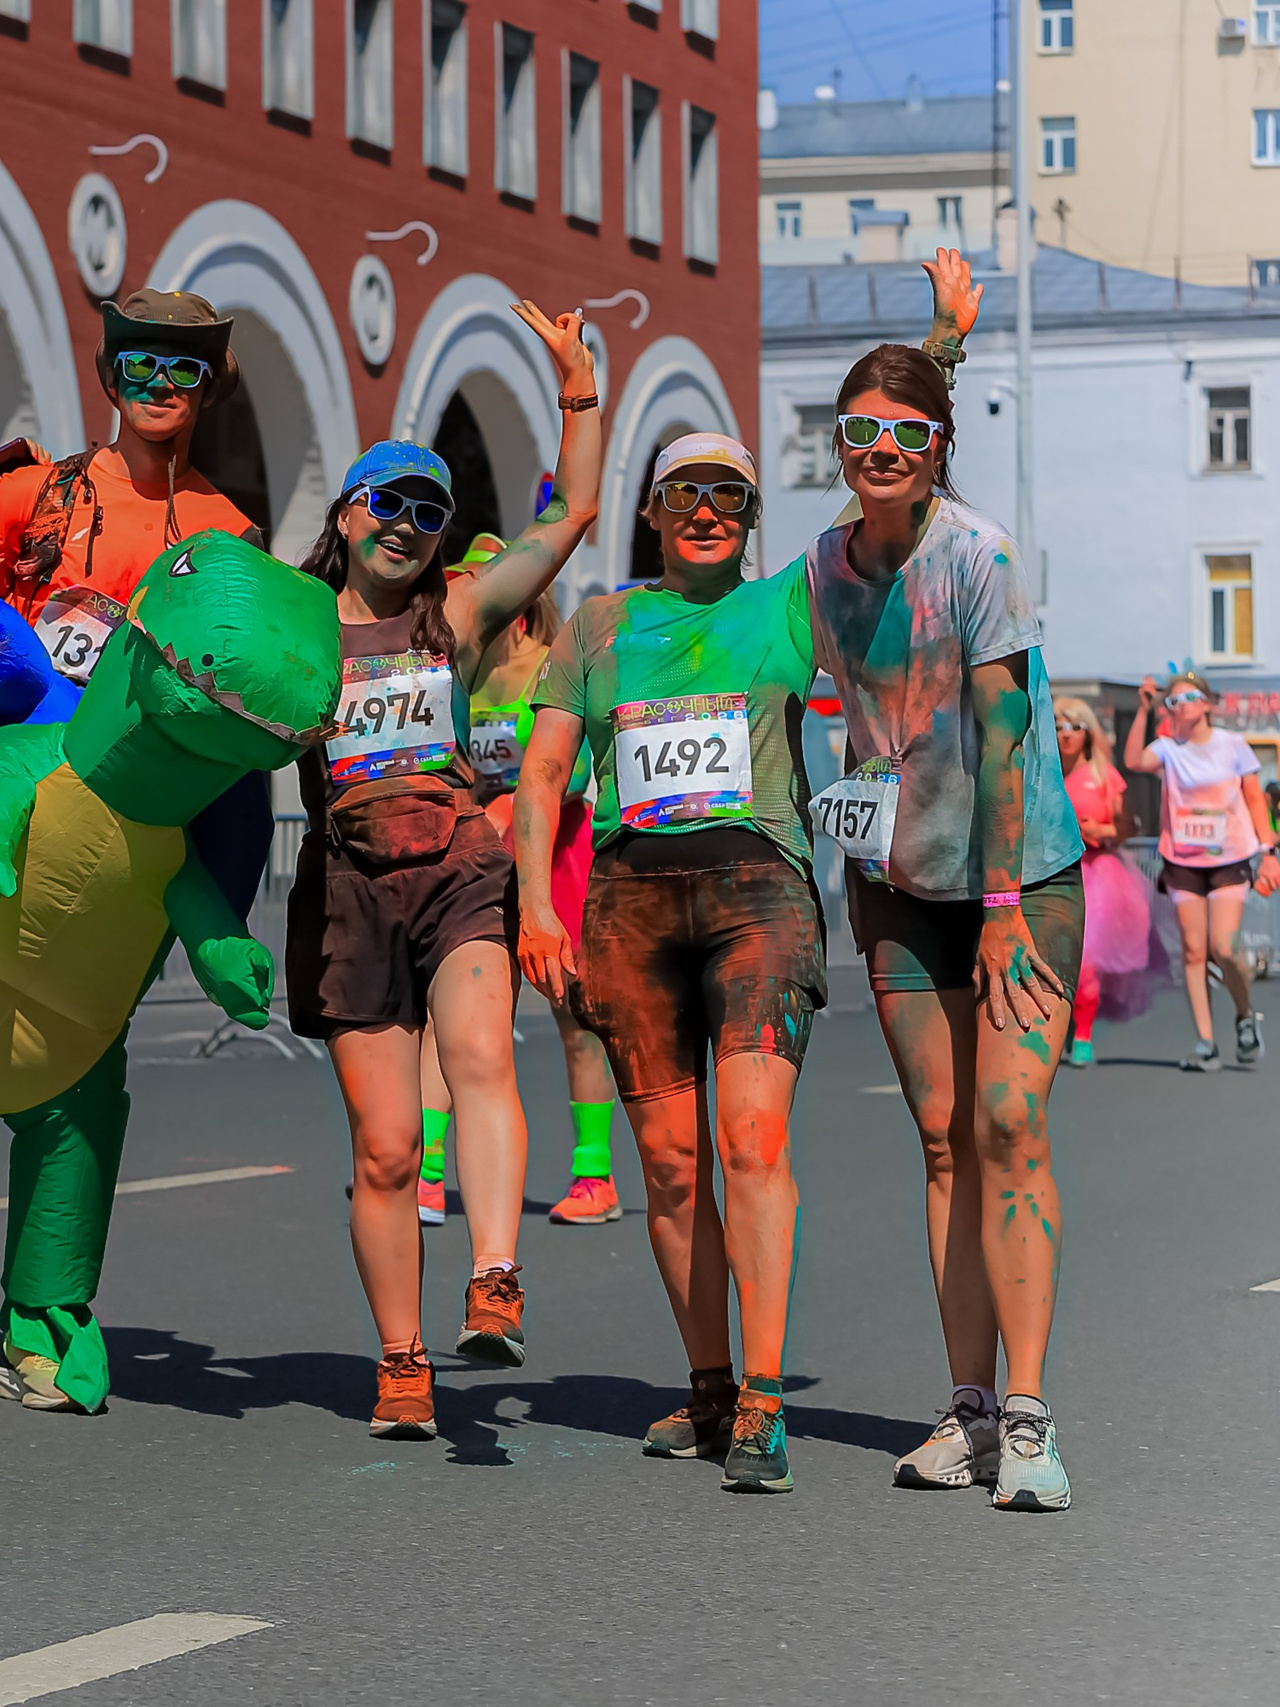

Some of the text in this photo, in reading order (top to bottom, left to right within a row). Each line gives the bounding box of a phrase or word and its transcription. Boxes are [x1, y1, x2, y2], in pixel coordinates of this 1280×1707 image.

[343, 690, 435, 736] 4974
[617, 696, 734, 723] КРАСОЧНЫЙ
[685, 711, 744, 721] 2026
[634, 736, 730, 782] 1492
[856, 773, 898, 784] 2026
[818, 797, 878, 840] 7157
